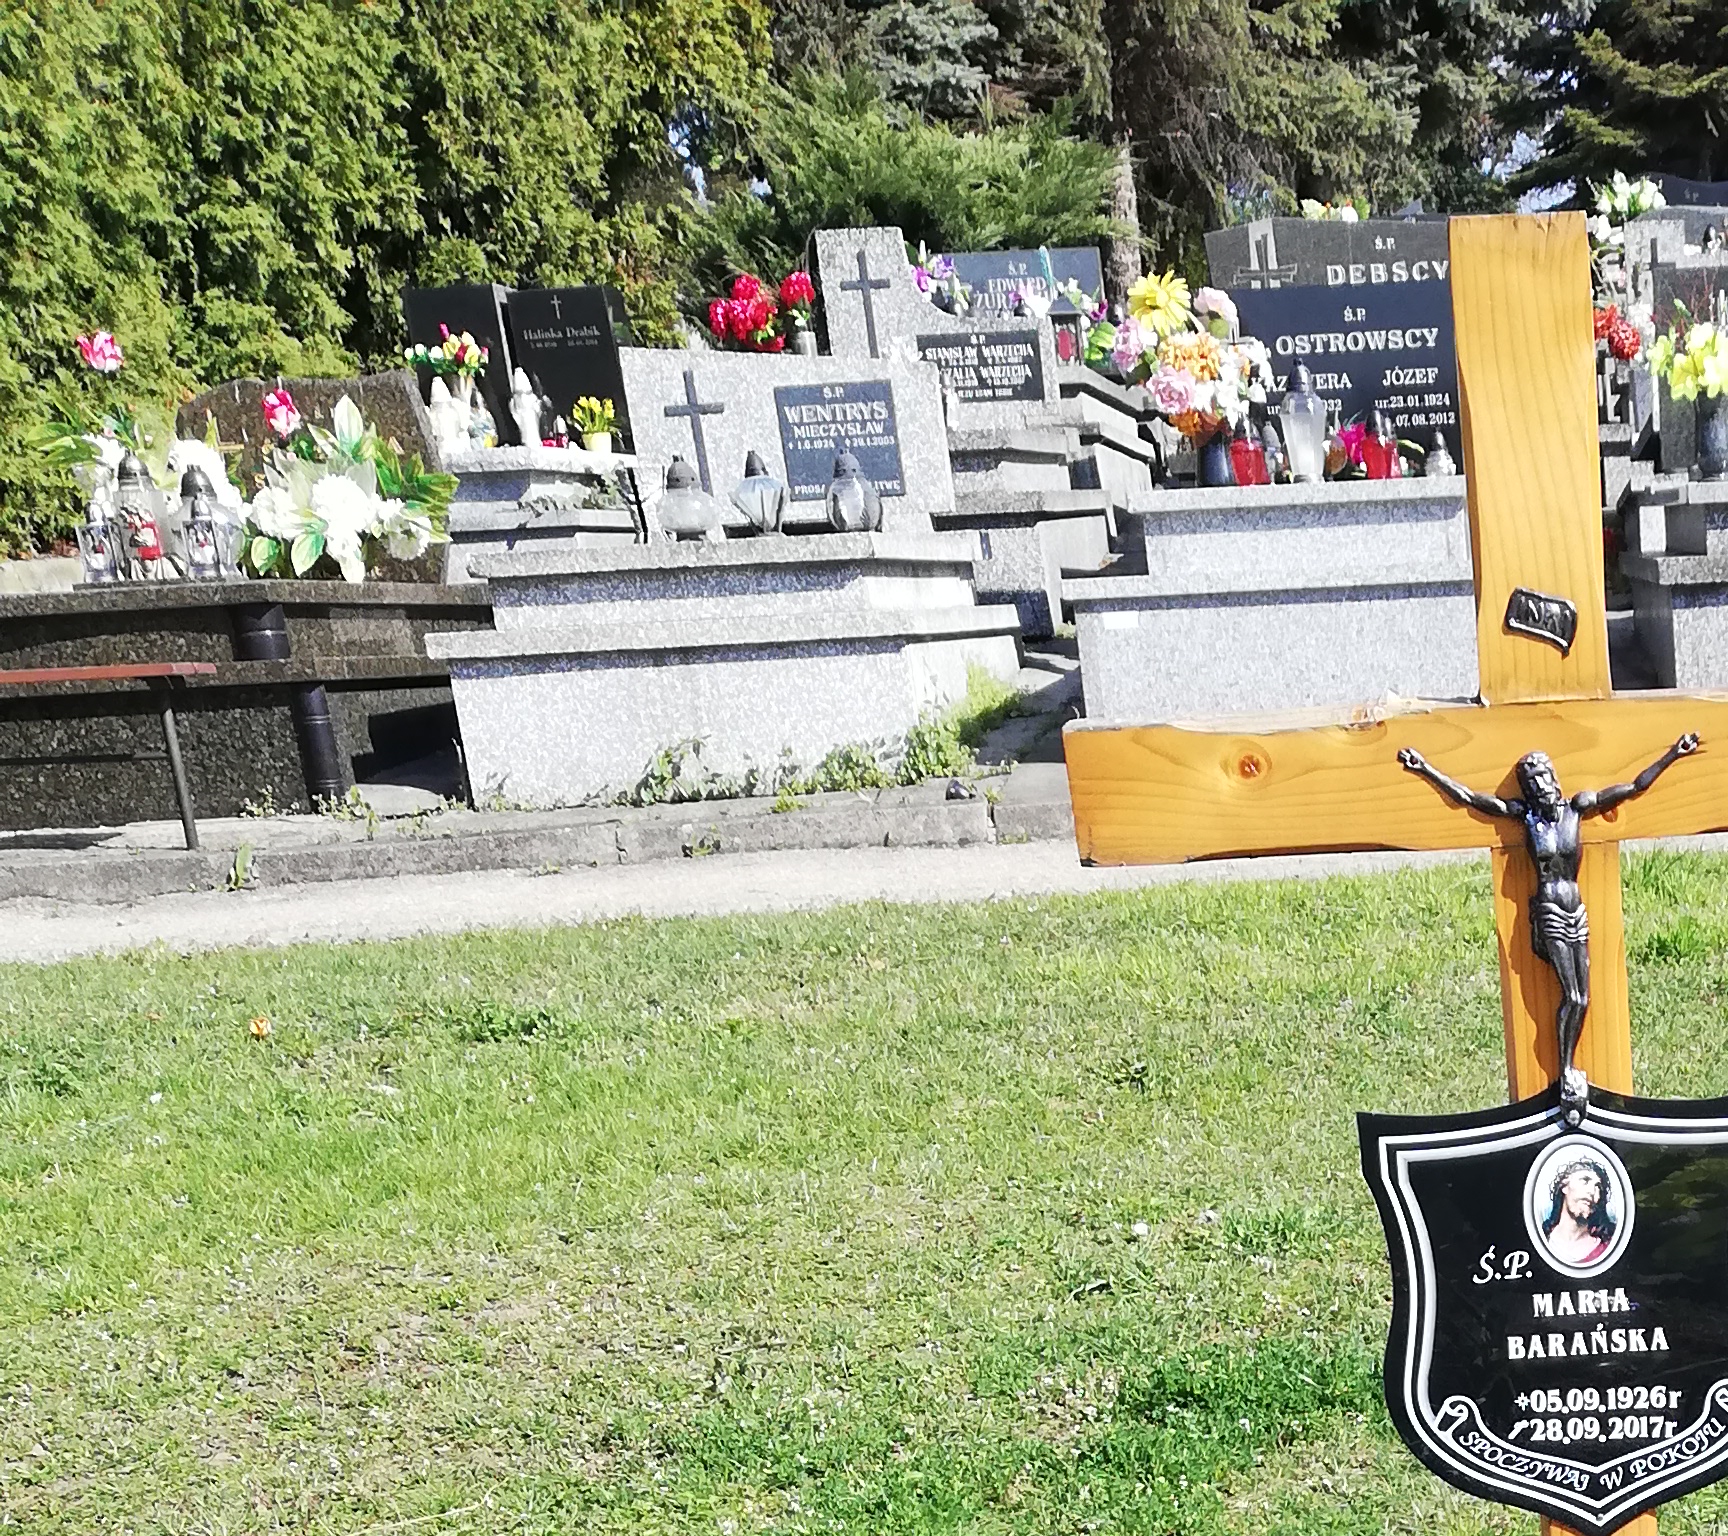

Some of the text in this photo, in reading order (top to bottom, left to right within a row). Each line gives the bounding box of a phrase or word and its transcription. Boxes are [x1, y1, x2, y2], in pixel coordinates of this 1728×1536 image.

[1275, 327, 1439, 356] OSTROWSCY
[1382, 366, 1439, 387] JÓZEF
[783, 400, 889, 424] WENTRYS
[792, 421, 884, 439] MIECZYSŁAW
[1472, 1245, 1533, 1284] Ś.P.
[1532, 1287, 1631, 1318] MARIA
[1507, 1322, 1670, 1360] BARAŃSKA
[1458, 1416, 1727, 1491] SPOCZYWAJ W POKOJU
